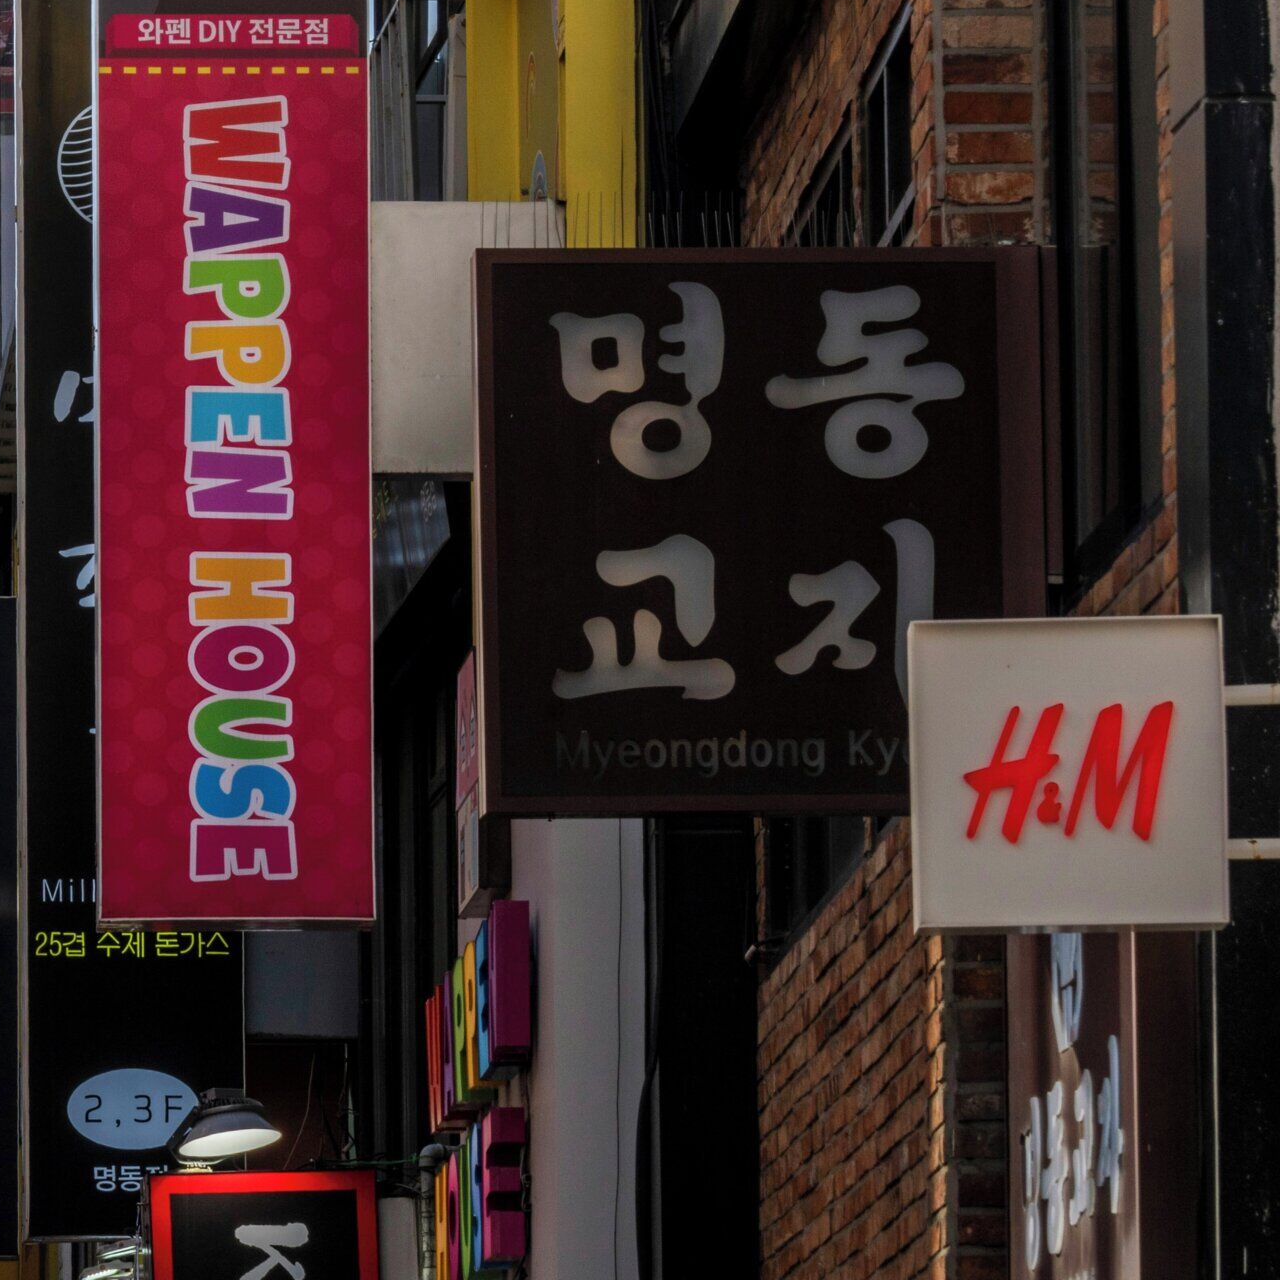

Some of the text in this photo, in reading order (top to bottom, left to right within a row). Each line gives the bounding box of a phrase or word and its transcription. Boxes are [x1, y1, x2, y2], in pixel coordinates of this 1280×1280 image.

[138, 17, 329, 45] 와펜 DIY 전문점
[182, 95, 294, 520] WAPPEN
[549, 281, 966, 480] 명동
[187, 551, 298, 882] HOUSE
[555, 729, 826, 781] Myeongdong
[963, 700, 1174, 843] H&M
[35, 931, 230, 958] 25겹 수제 돈가스
[83, 1094, 183, 1127] 2,3F
